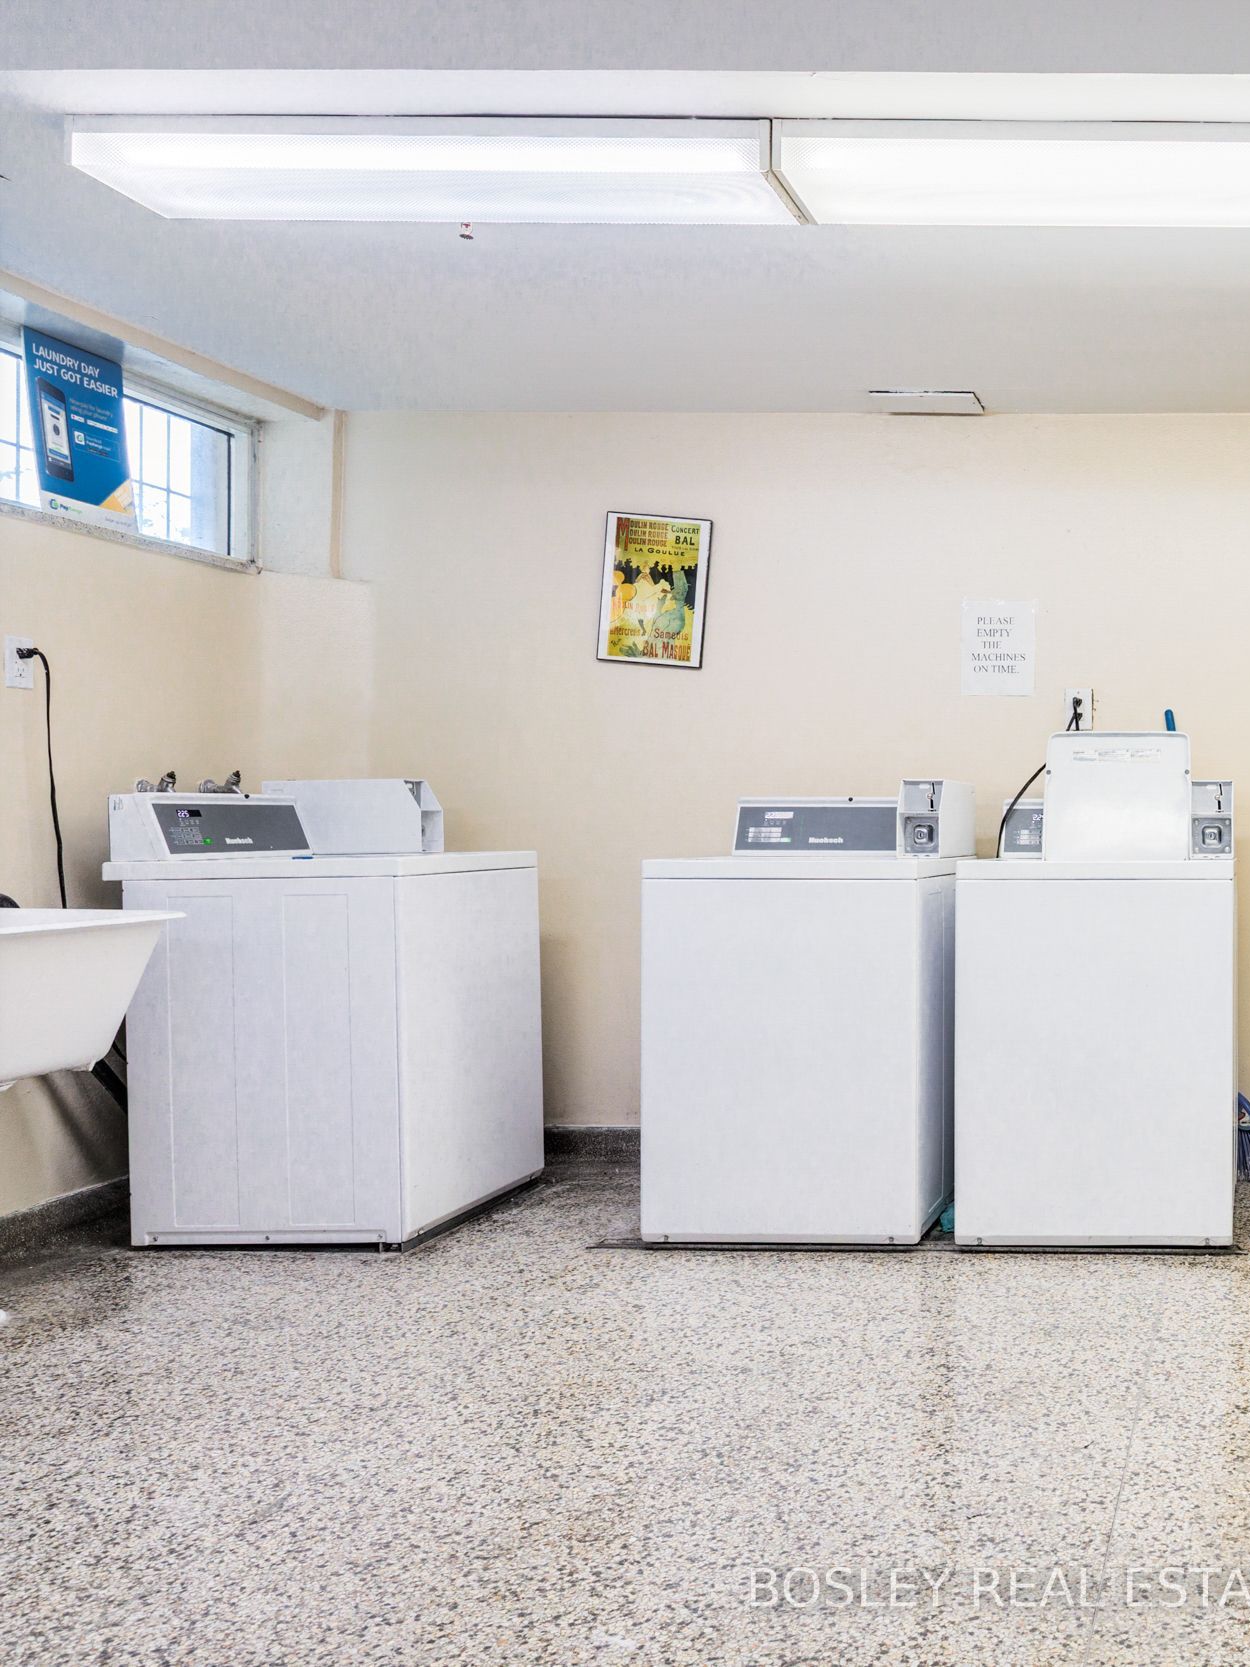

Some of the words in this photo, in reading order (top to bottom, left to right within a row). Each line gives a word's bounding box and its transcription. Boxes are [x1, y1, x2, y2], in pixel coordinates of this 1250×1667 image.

[33, 343, 79, 371] LAUNDRY
[81, 362, 100, 378] DAY
[34, 358, 58, 377] JUST
[61, 369, 82, 385] GOT
[84, 377, 118, 399] EASIER
[671, 524, 700, 535] CONCERT
[675, 535, 695, 546] BAL
[647, 547, 685, 556] GOULUE
[977, 616, 1016, 625] PLEASE
[977, 628, 1012, 637] EMPTY
[642, 640, 658, 658] BAL
[981, 641, 1002, 649] THE
[971, 653, 1026, 662] MACHINES
[973, 665, 988, 673] ON
